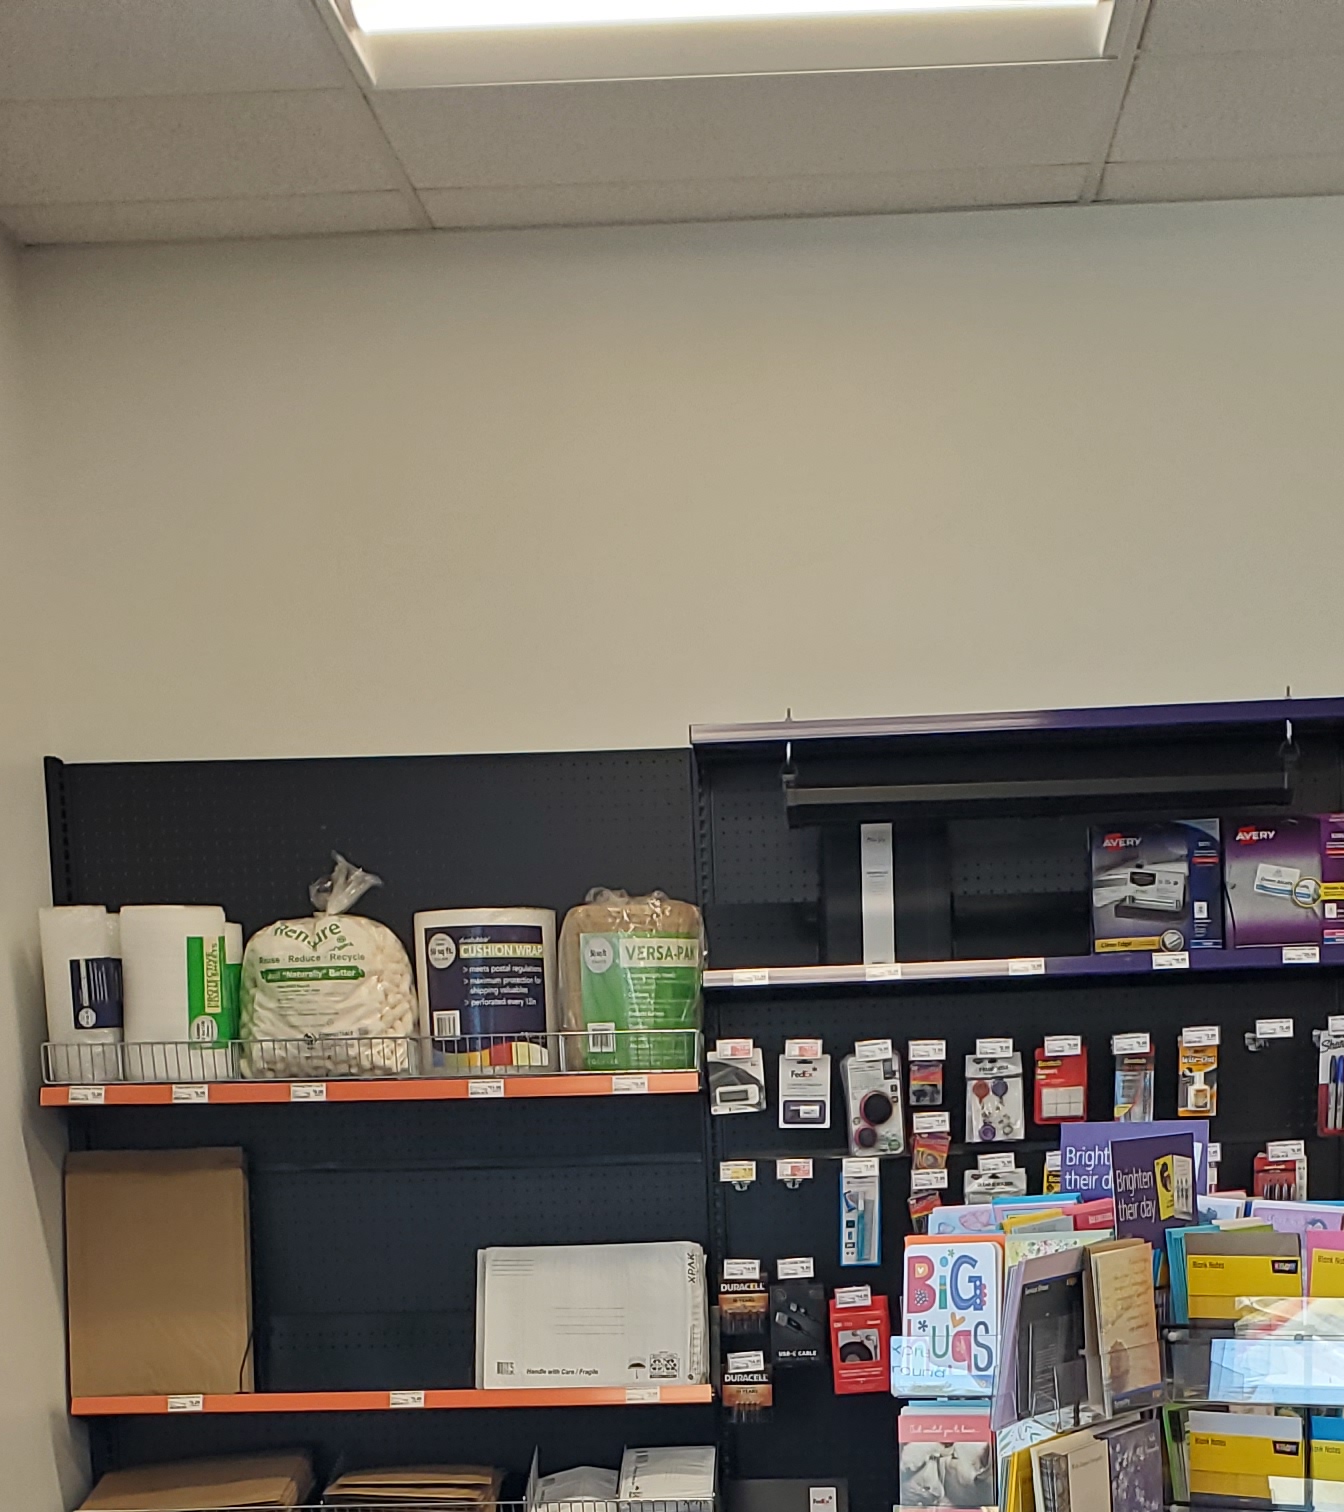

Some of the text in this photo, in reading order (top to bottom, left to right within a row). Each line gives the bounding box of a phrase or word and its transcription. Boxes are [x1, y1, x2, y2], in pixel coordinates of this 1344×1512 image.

[1235, 830, 1275, 842] AVERY
[1102, 837, 1142, 849] AVERY
[461, 945, 543, 956] CUSHION WRAP
[259, 952, 365, 964] Reuse Reduce Recycle
[328, 968, 356, 977] Better
[471, 999, 506, 1007] perforated
[791, 1069, 813, 1079] FedEx
[1065, 1172, 1097, 1190] their
[1116, 1168, 1154, 1198] Brighten
[1118, 1200, 1138, 1222] their
[1140, 1199, 1156, 1223] day
[1318, 1255, 1334, 1264] Blank
[688, 1252, 696, 1284] XPAK
[721, 1282, 765, 1291] DURACELL
[579, 1368, 599, 1376] Fragile
[724, 1374, 768, 1382] DURACELL
[1325, 1446, 1341, 1455] Notes
